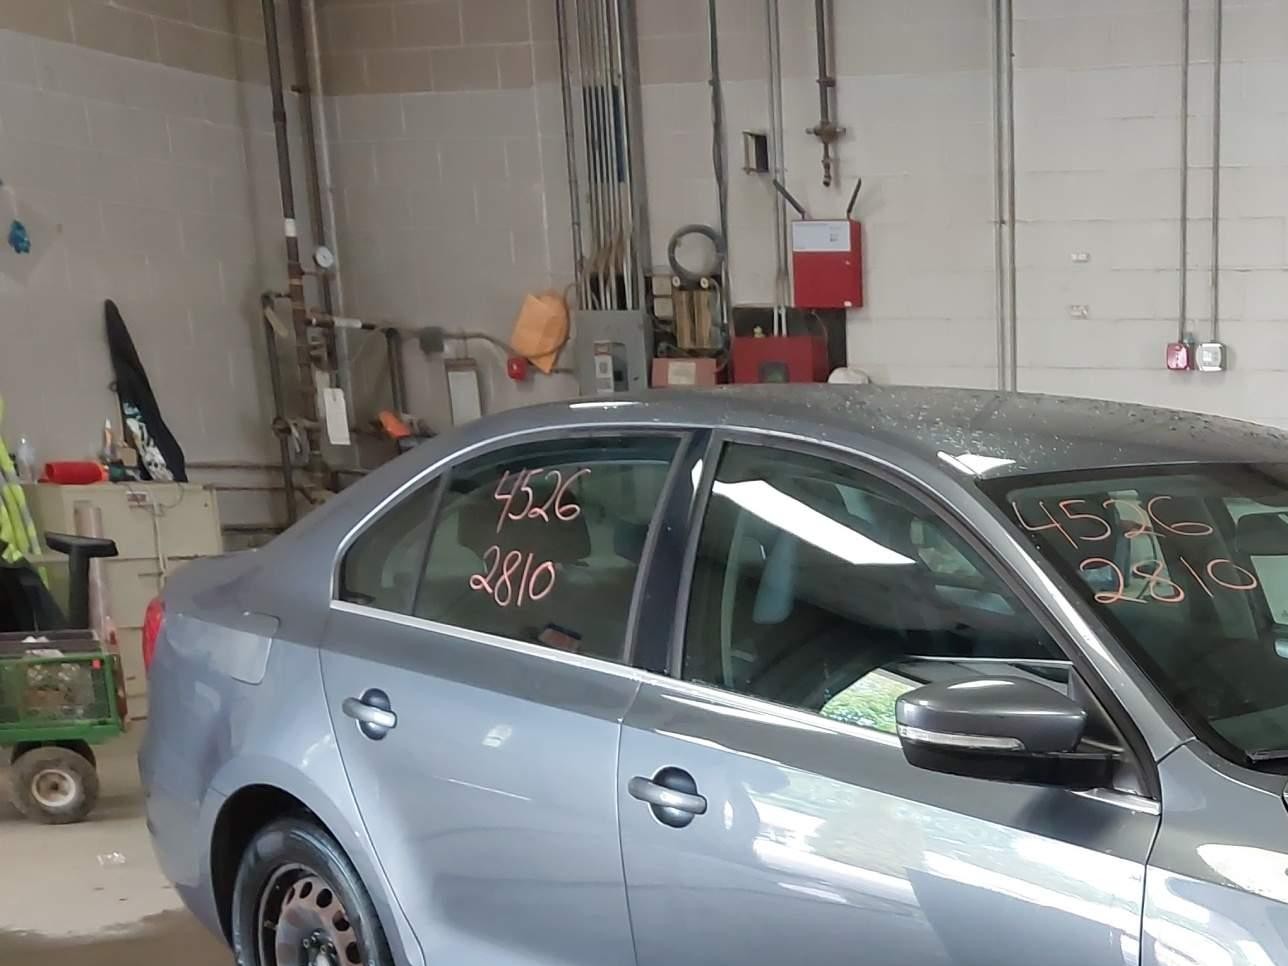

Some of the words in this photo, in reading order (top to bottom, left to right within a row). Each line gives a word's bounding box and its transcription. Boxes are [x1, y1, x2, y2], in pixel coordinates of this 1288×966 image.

[494, 467, 592, 534] 4526
[1011, 495, 1214, 550] 4526
[469, 545, 556, 607] 2810
[1094, 557, 1258, 604] 2810
